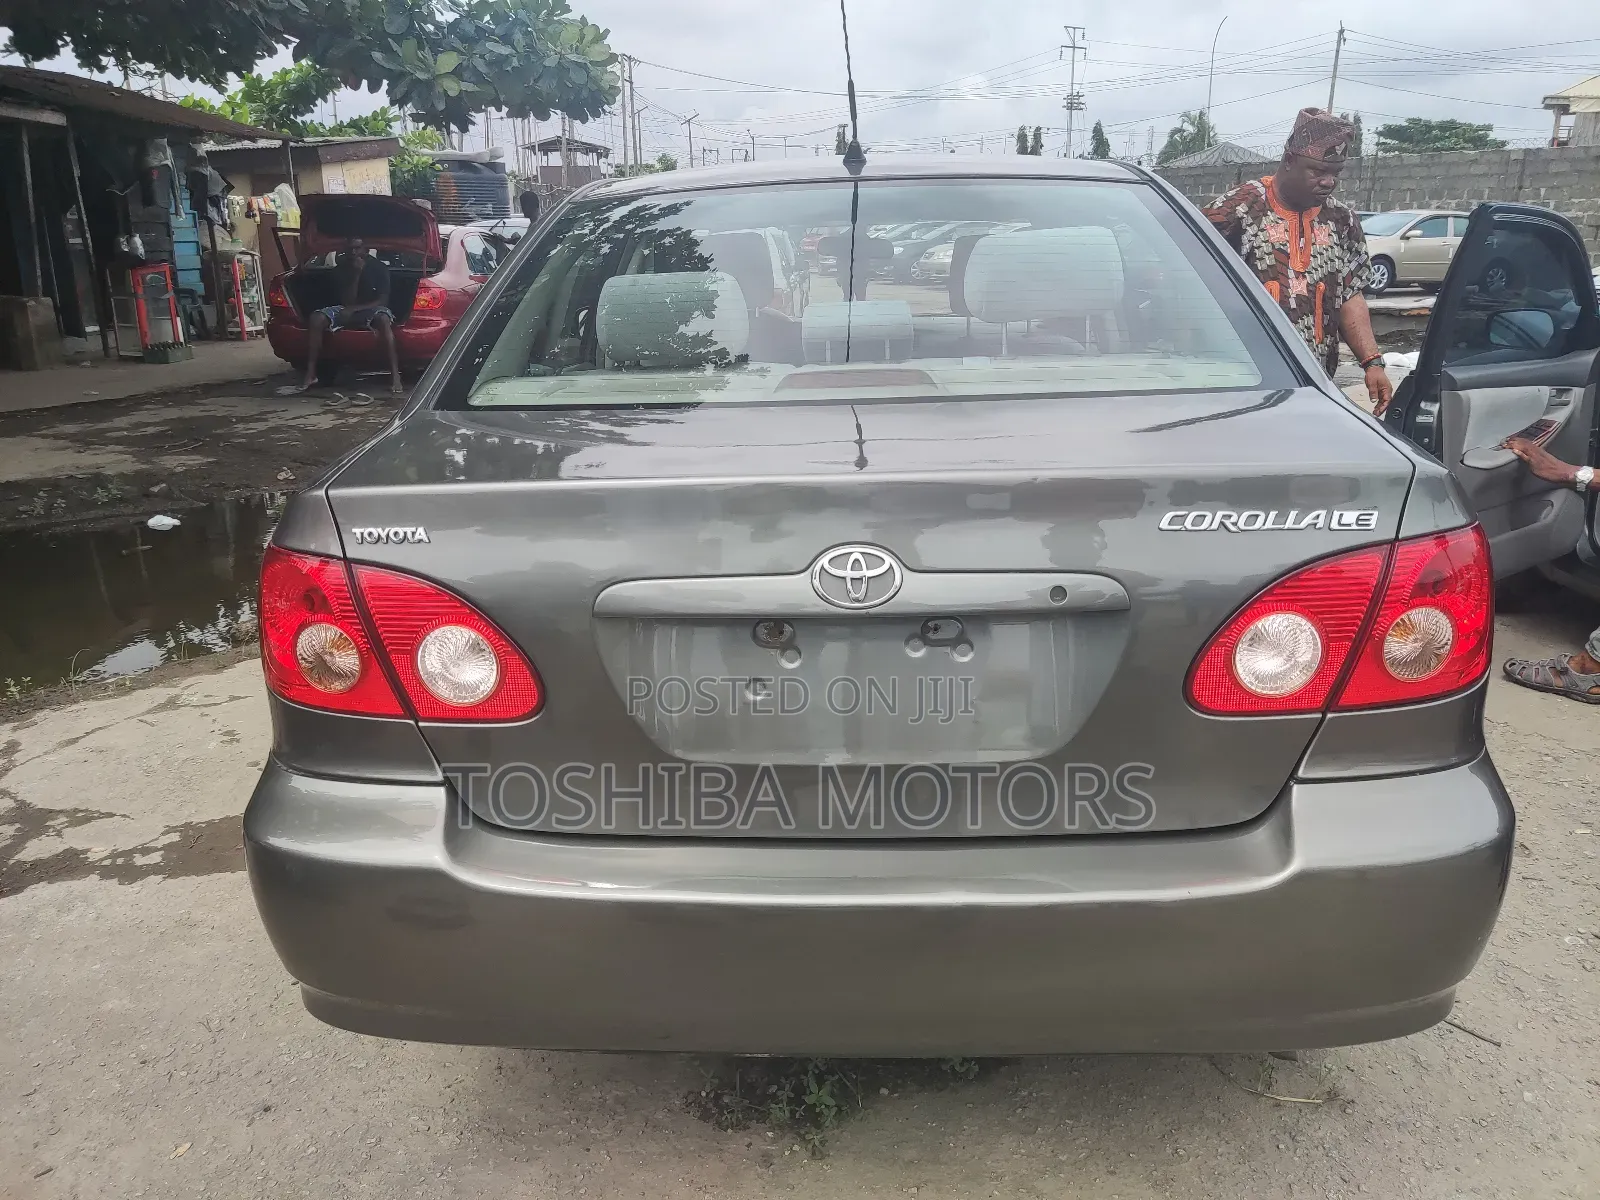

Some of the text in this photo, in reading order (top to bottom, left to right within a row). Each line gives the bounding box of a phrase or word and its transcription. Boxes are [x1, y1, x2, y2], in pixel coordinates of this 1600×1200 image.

[1158, 509, 1378, 533] COROLLA LE
[351, 526, 431, 545] TOYOTA
